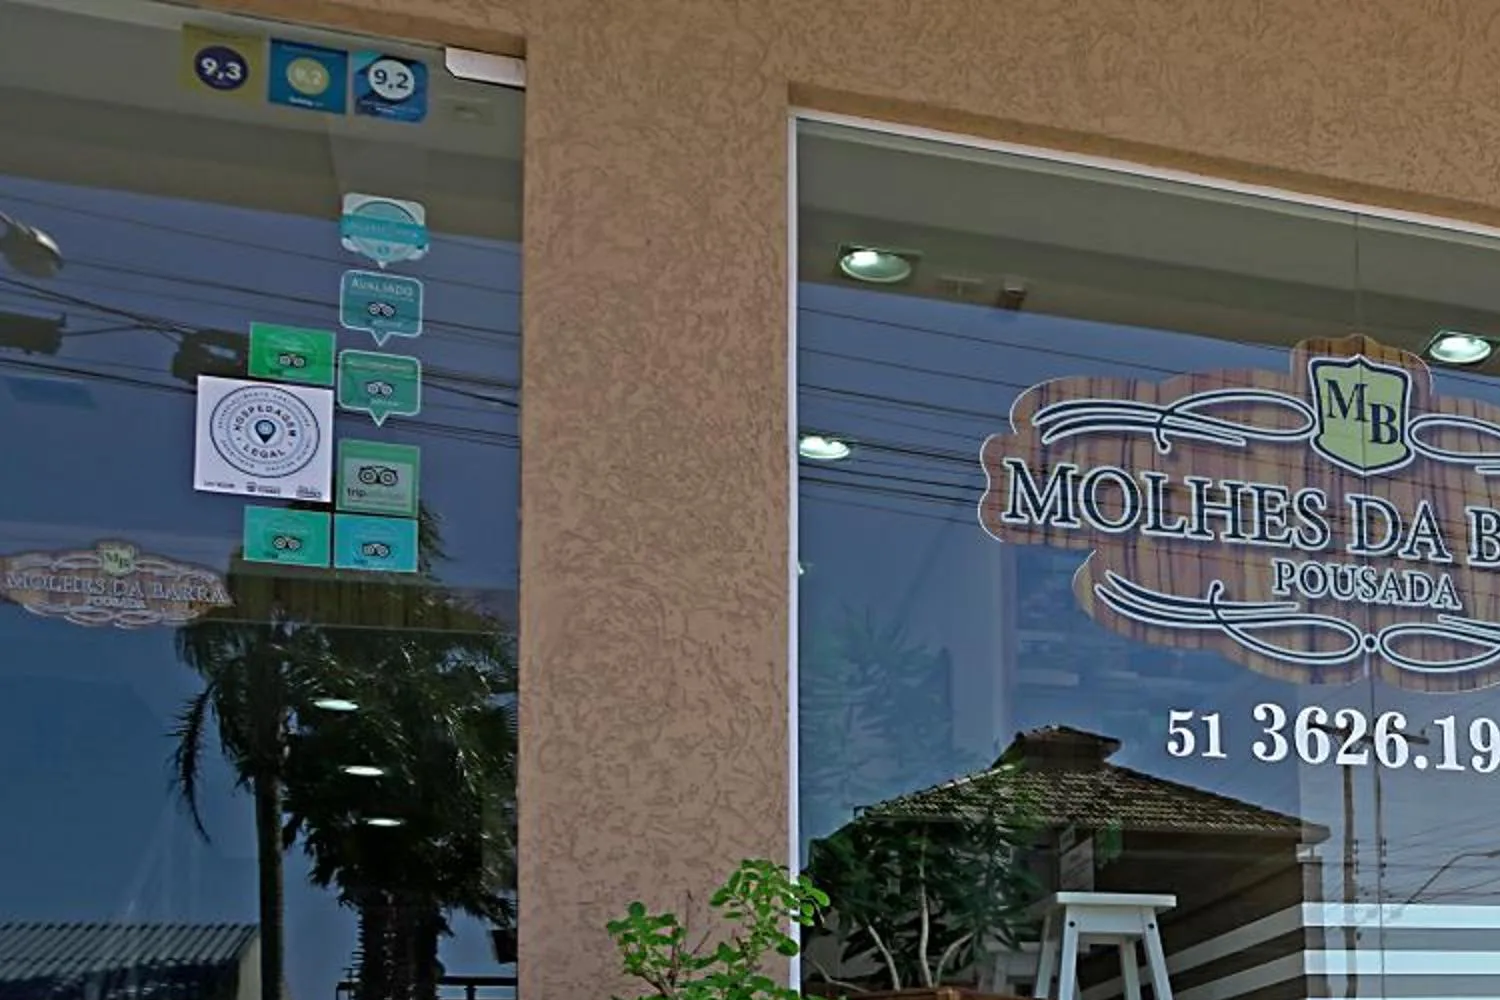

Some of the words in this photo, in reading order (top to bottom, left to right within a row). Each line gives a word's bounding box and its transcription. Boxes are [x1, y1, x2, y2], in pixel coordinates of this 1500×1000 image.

[201, 57, 241, 81] 9,3
[234, 405, 297, 437] HOSPEDAGEM
[1326, 376, 1399, 447] MB
[243, 445, 285, 459] LEGAL
[1002, 456, 1331, 552] MOLHES
[1346, 493, 1452, 563] DA
[112, 581, 145, 598] DA
[1272, 559, 1462, 610] POUSADA
[1166, 708, 1228, 761] 51
